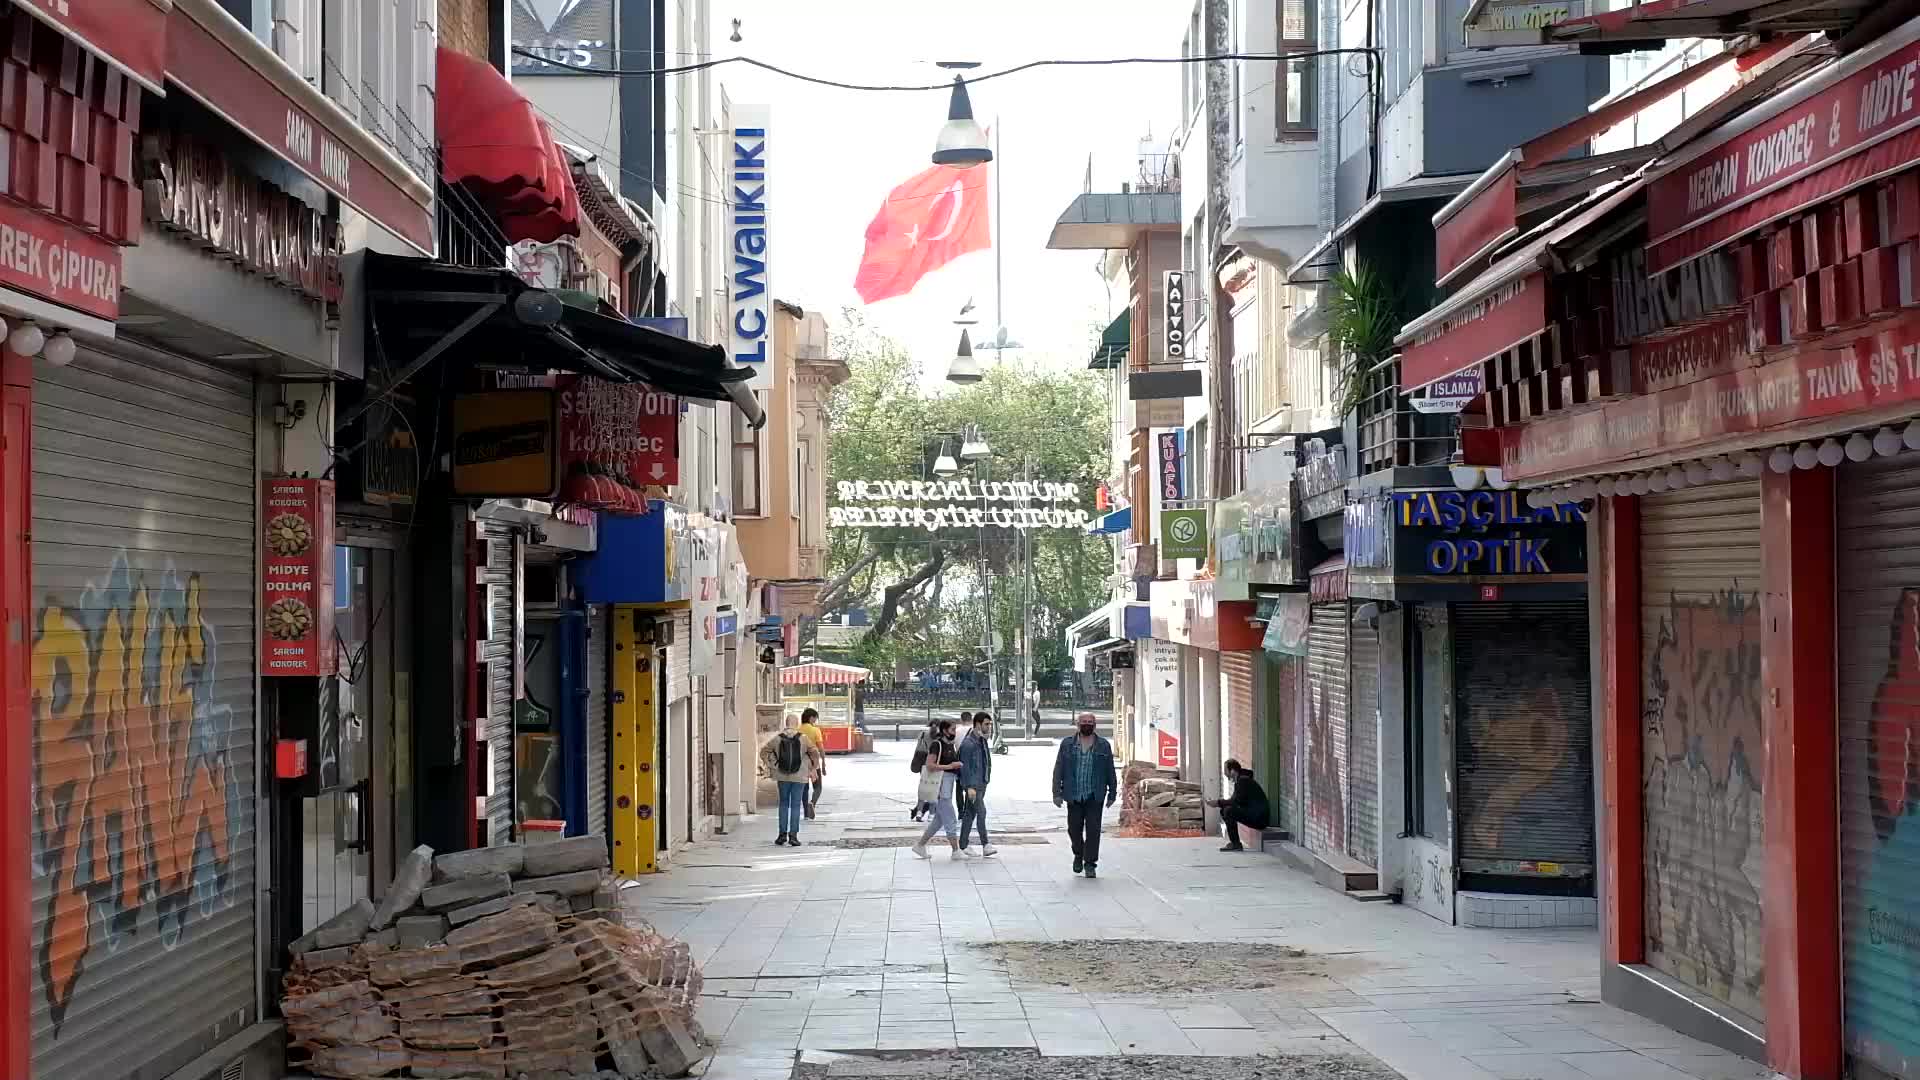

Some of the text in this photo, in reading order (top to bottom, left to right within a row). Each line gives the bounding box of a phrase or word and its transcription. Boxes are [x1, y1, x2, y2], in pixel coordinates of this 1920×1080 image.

[1688, 60, 1917, 214] MERCAN KOKOREÇ & MİDYE
[0, 223, 117, 304] REK ÇİPURA
[1807, 358, 1863, 401] TAVUK
[1870, 343, 1899, 397] ŞİŞ
[269, 565, 309, 575] MİDYE
[1427, 531, 1551, 574] OPTİK
[266, 582, 311, 592] DOLMA
